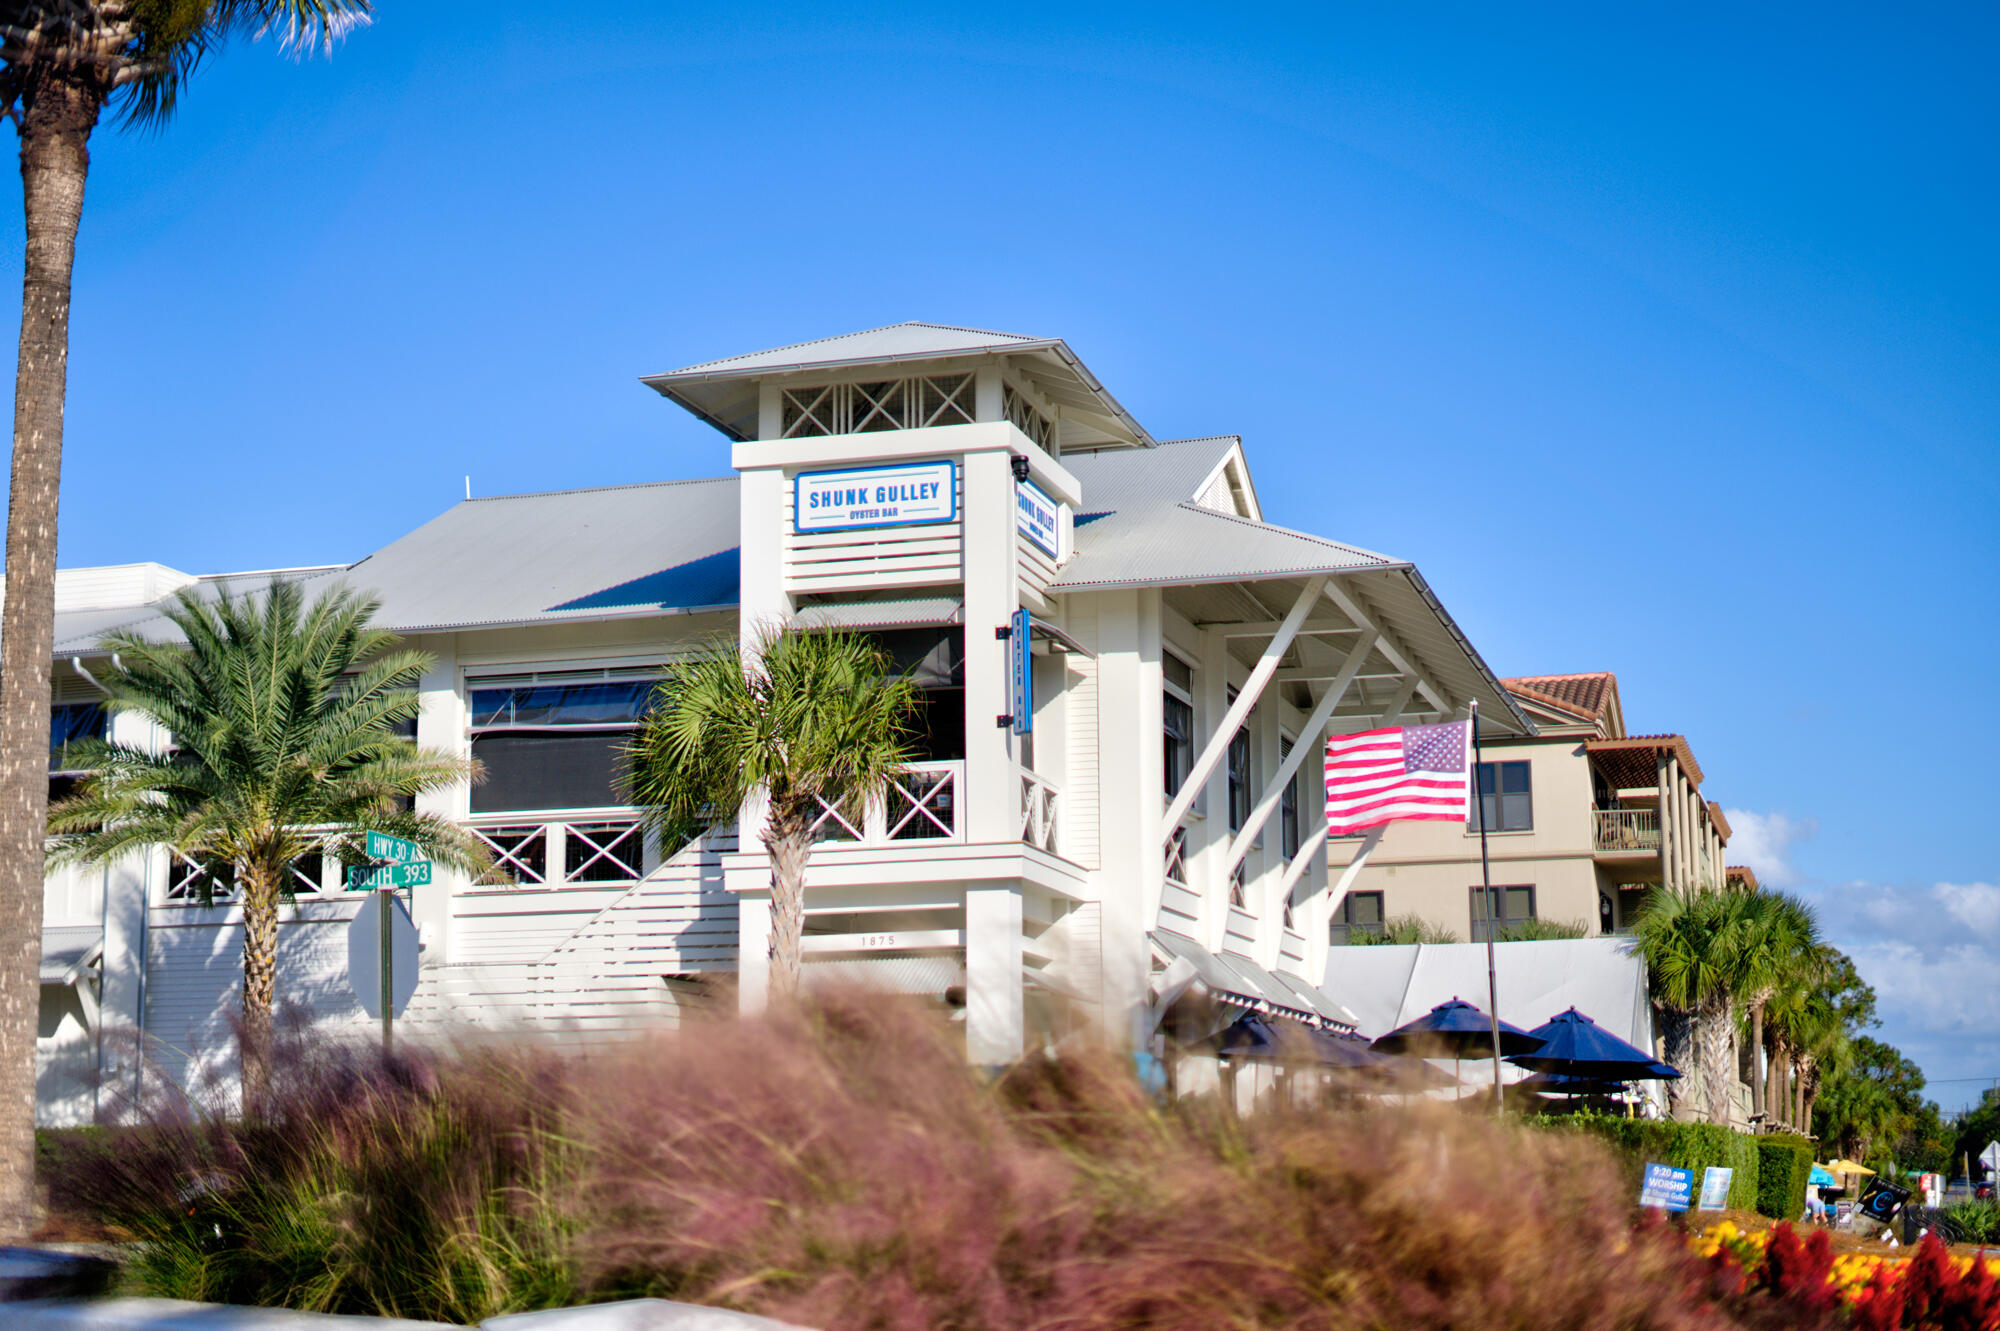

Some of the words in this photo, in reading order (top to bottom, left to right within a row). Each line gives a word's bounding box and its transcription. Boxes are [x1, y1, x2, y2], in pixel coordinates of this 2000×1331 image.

[810, 487, 868, 508] SHUNK
[876, 482, 939, 503] GULLEY
[850, 508, 880, 520] OYSTER
[882, 507, 898, 517] BAR
[374, 835, 393, 857] HWY
[350, 865, 392, 886] SOUTH
[403, 863, 428, 883] 393
[862, 935, 895, 946] 1875
[1653, 1166, 1671, 1177] 9:20
[1672, 1171, 1685, 1180] am
[1649, 1177, 1688, 1192] WORSHIP
